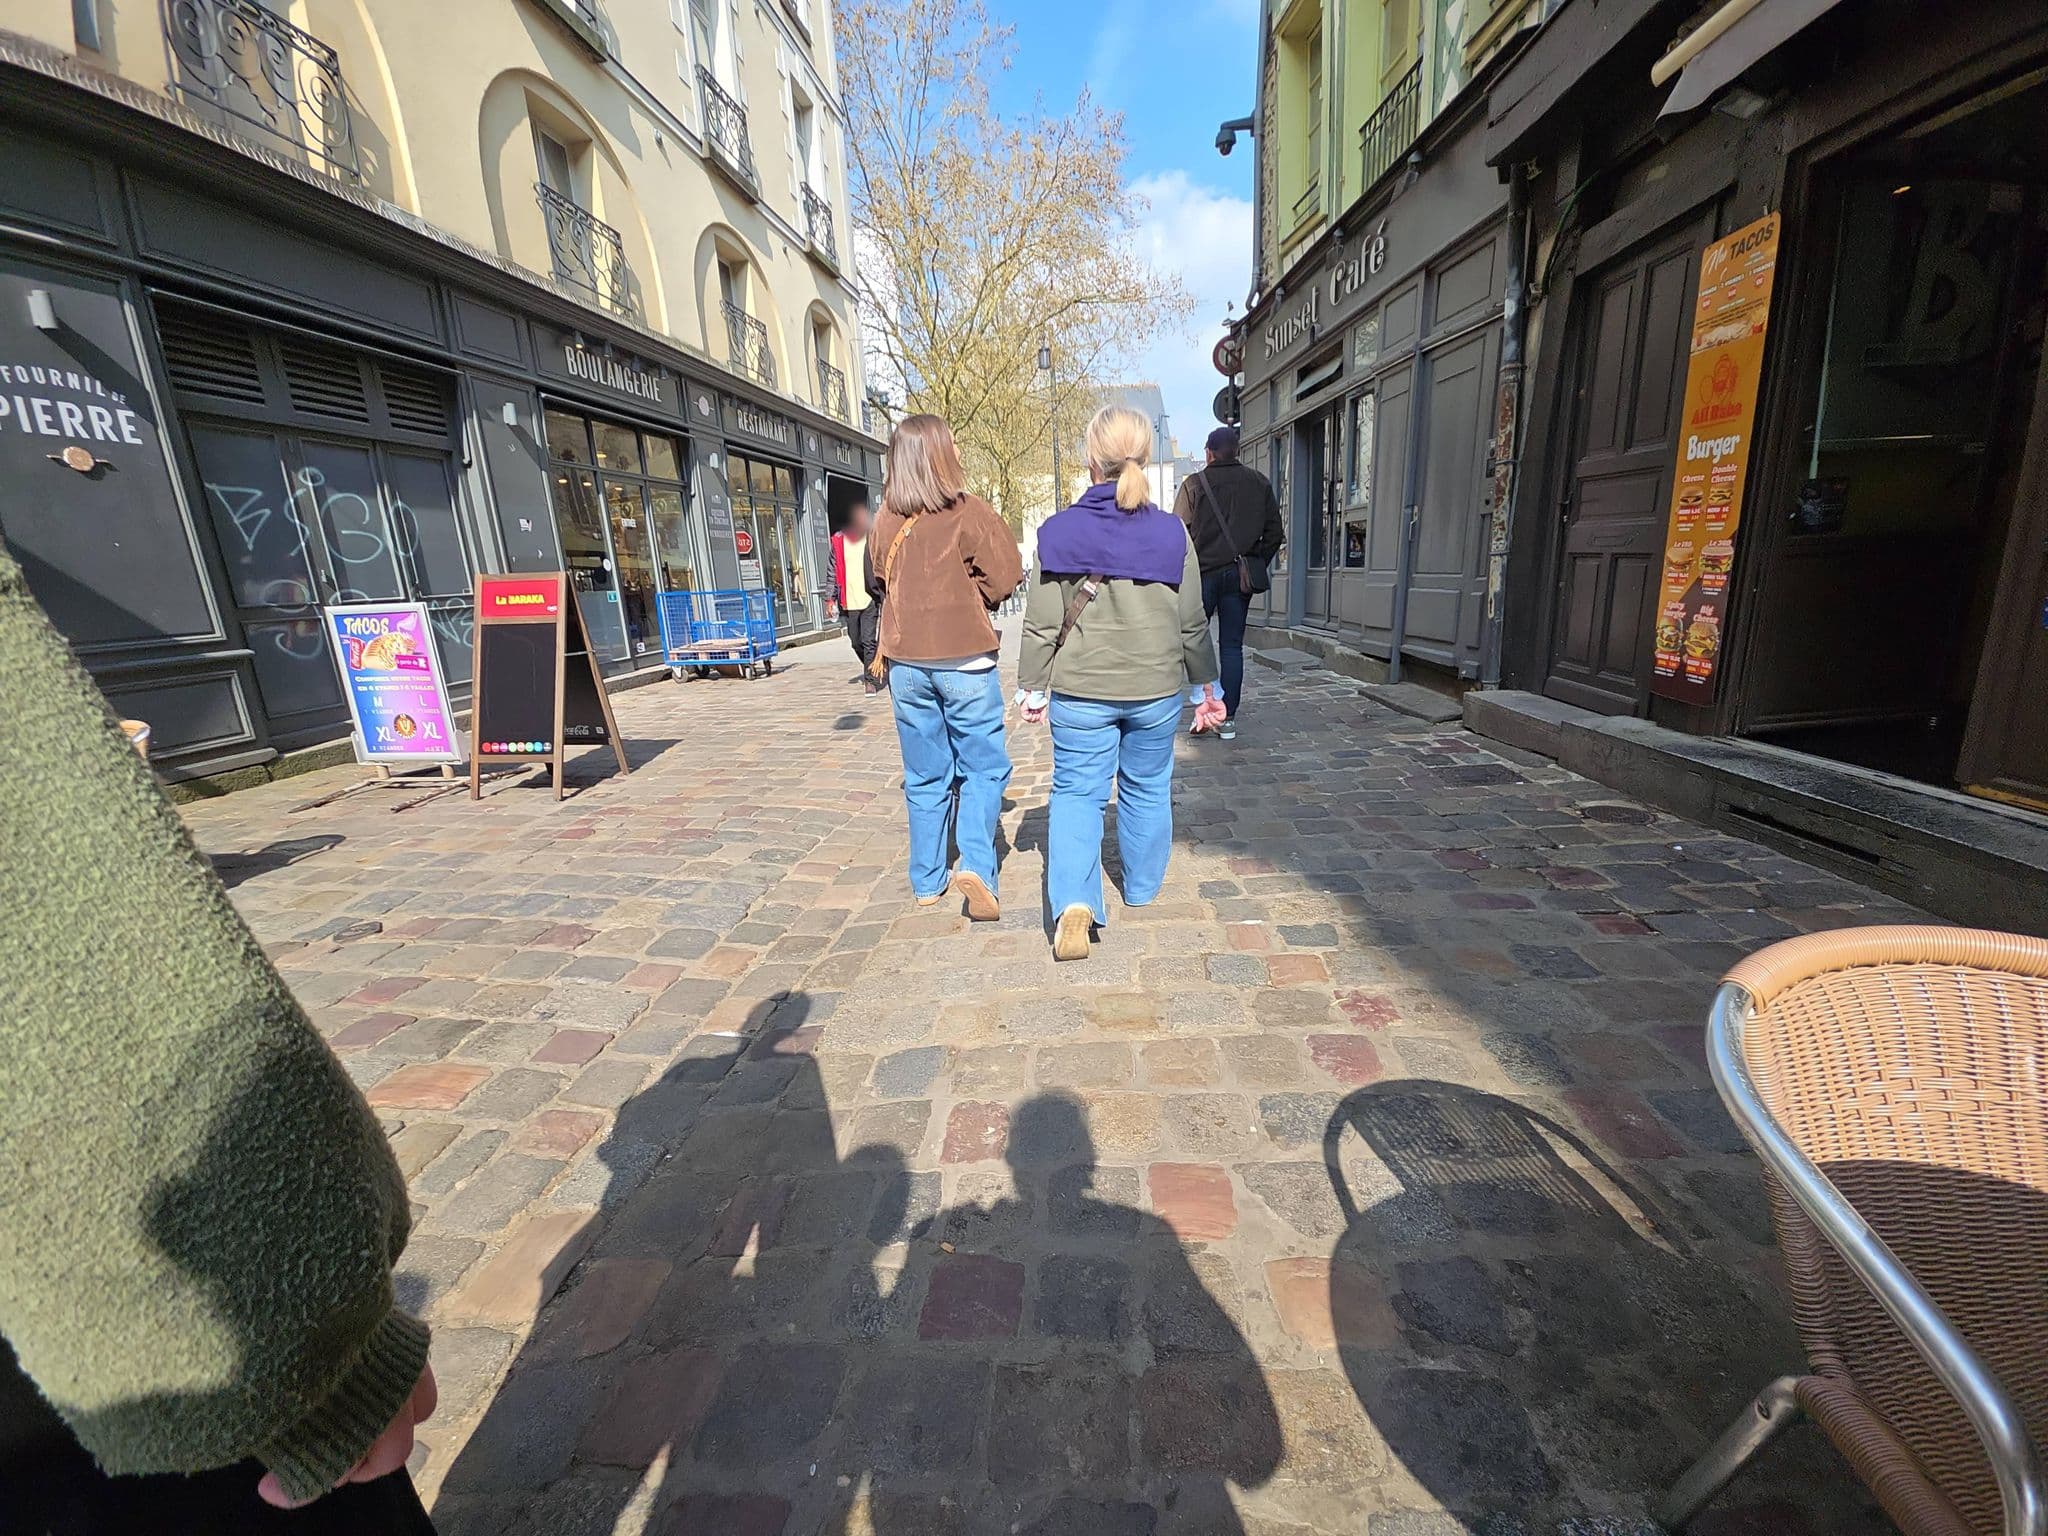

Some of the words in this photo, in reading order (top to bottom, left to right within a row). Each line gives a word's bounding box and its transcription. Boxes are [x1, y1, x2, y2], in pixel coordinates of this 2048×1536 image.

[1730, 222, 1775, 260] TACOS
[1265, 286, 1320, 360] Sunset
[1329, 217, 1386, 306] Café
[0, 365, 106, 398] FOURNIL
[564, 345, 662, 402] BOULANGERIE
[737, 408, 788, 445] RESTAURANT
[1687, 434, 1740, 464] Burger
[1711, 473, 1737, 484] Cheese
[343, 617, 390, 637] TACOS
[375, 726, 396, 742] XL
[422, 721, 443, 739] XL
